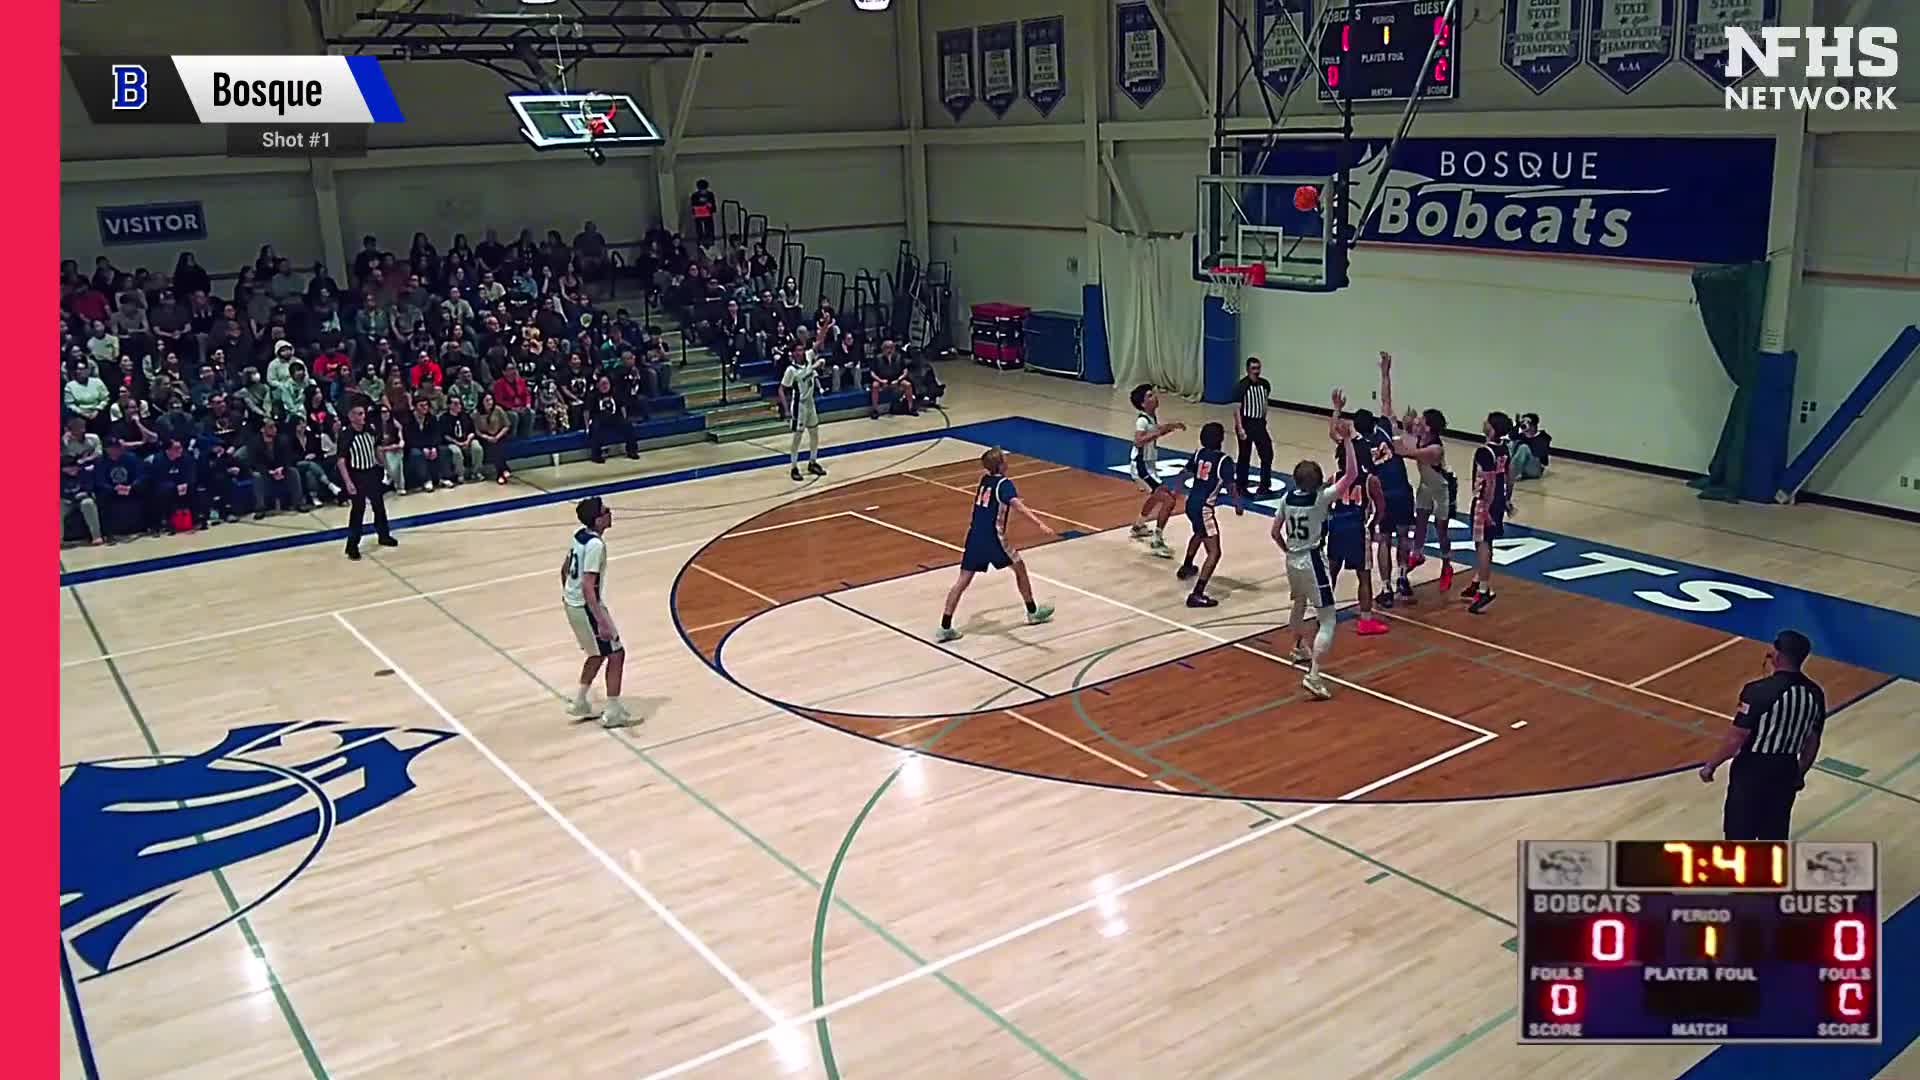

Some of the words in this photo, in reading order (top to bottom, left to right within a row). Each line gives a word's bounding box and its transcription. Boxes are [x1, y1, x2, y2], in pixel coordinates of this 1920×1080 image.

[1413, 2, 1445, 16] GUEST
[1440, 151, 1599, 180] BOSQUE
[105, 212, 199, 236] VISITOR
[1378, 187, 1632, 248] Bobcats
